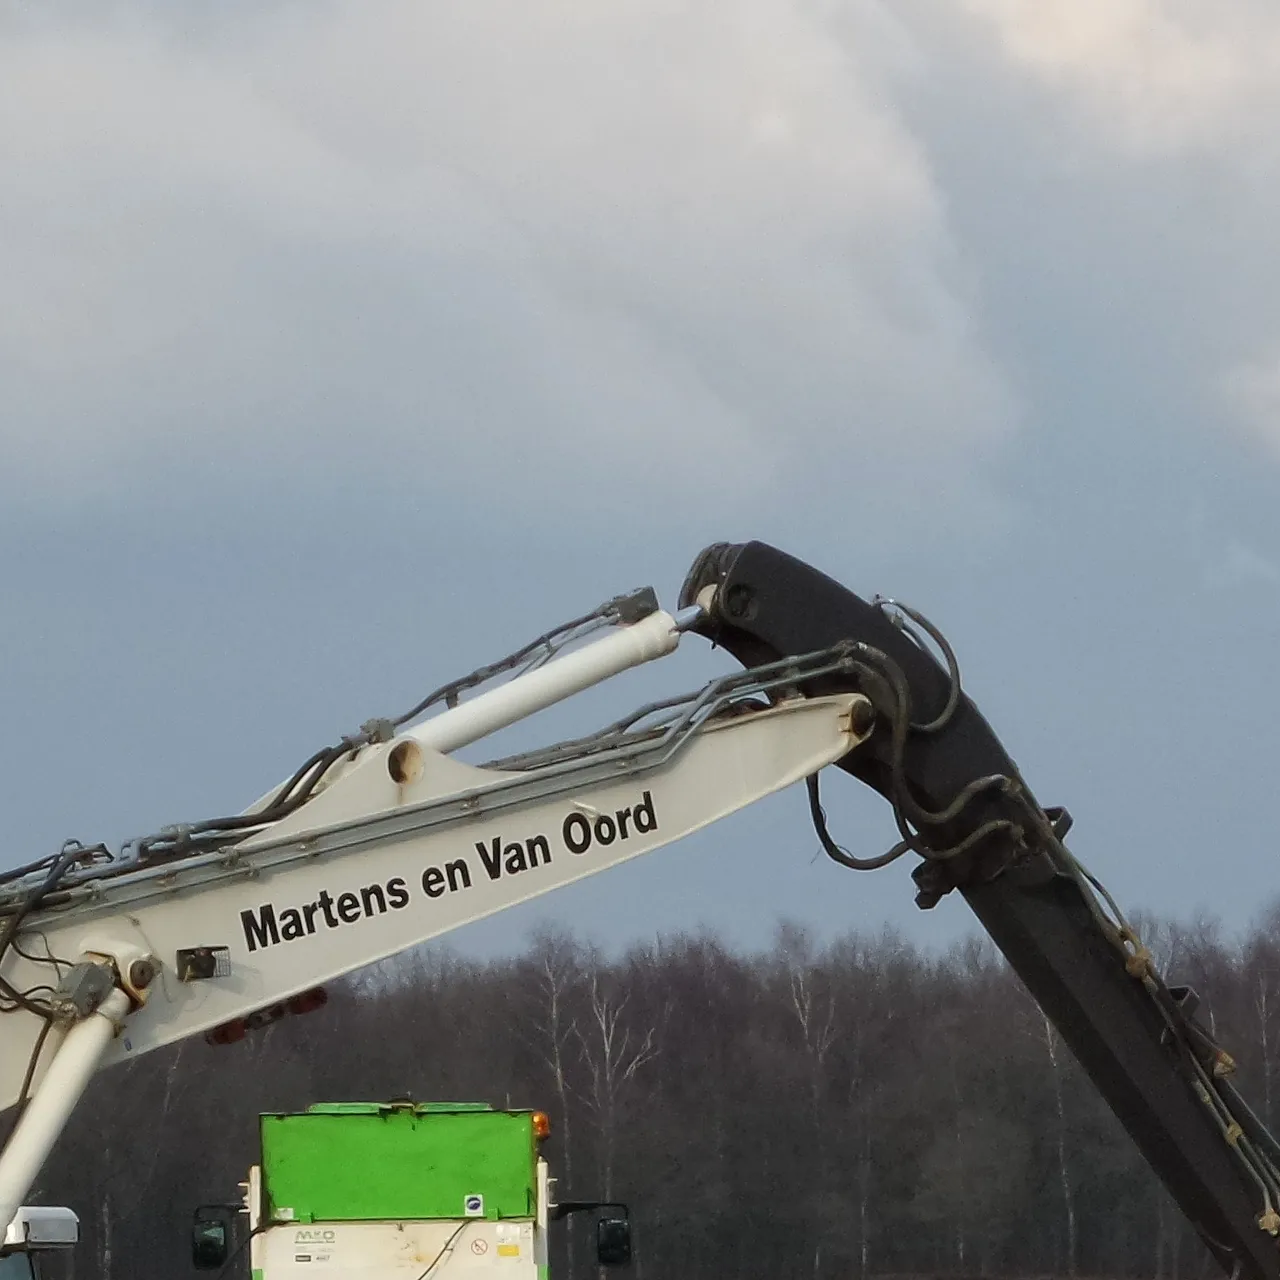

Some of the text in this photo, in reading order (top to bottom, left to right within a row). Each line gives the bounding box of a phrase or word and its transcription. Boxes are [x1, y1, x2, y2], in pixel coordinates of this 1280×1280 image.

[240, 791, 658, 952] Martens en Van Oord
